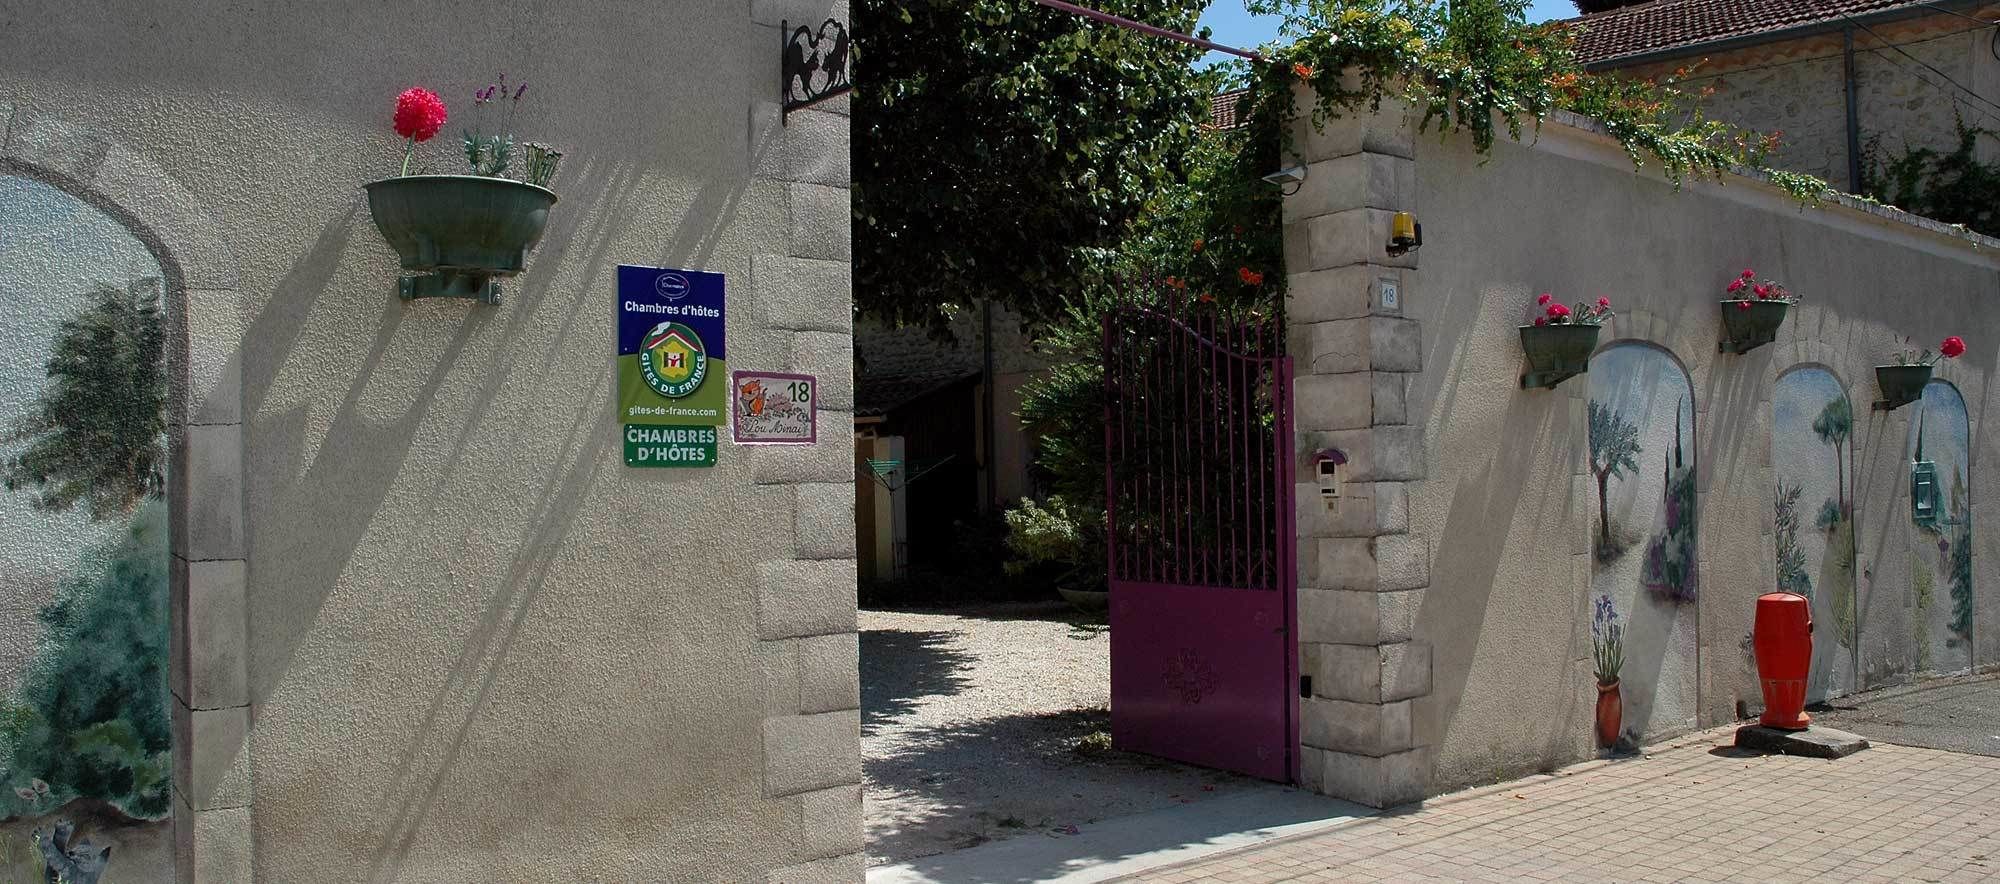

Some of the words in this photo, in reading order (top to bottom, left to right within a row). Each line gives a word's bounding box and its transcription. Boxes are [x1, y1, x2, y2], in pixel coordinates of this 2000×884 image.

[1383, 288, 1395, 303] 18
[625, 301, 679, 314] Chambres
[681, 305, 719, 317] d'hôtes
[641, 353, 659, 386] GITES
[661, 384, 675, 394] DE
[679, 355, 704, 393] FRANCE
[787, 381, 810, 402] 18
[629, 405, 717, 416] gites-de-france.com
[627, 429, 715, 443] CHAMBRES
[638, 444, 705, 461] D'HÔTES
